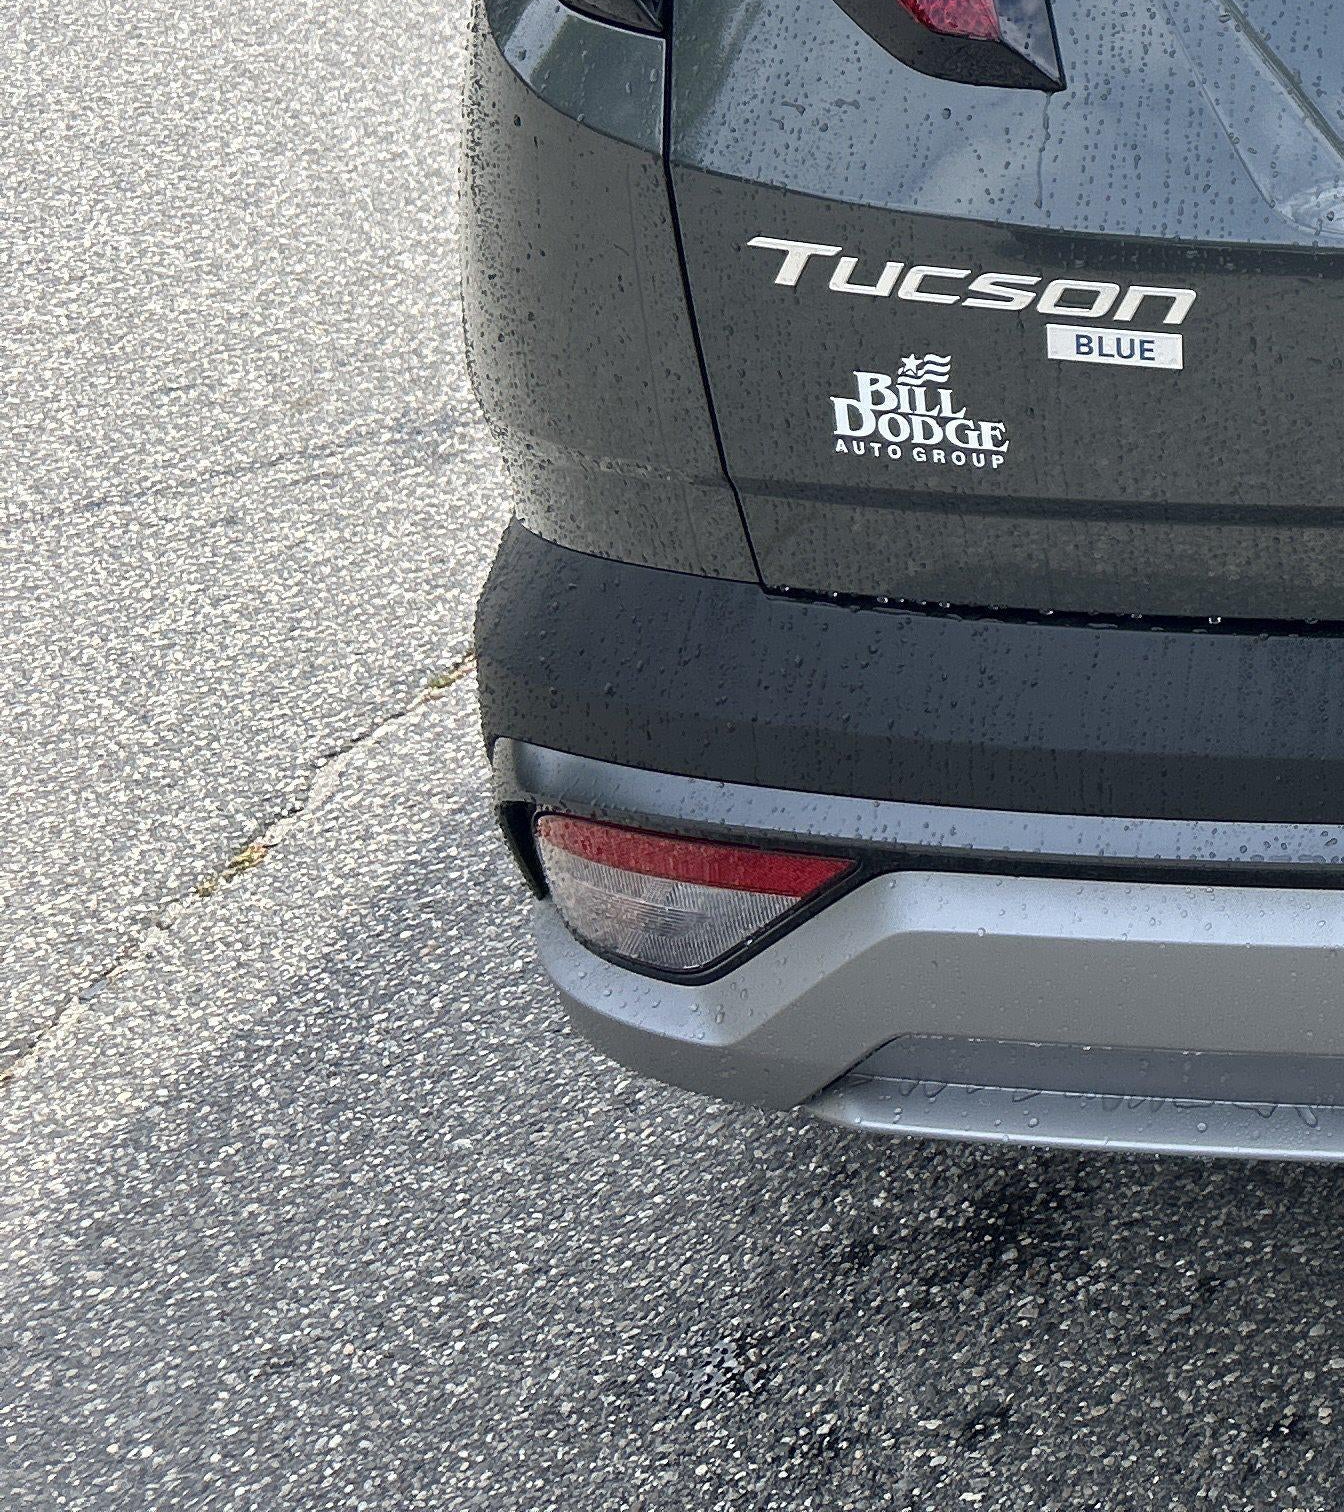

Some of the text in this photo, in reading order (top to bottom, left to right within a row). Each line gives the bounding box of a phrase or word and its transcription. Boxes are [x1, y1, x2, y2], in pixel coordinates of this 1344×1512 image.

[746, 236, 1198, 325] TUCSON
[1075, 334, 1156, 361] BLUE
[854, 371, 967, 418] BILL
[829, 397, 1009, 454] DODGE
[834, 438, 1006, 469] AUTO GROUP
